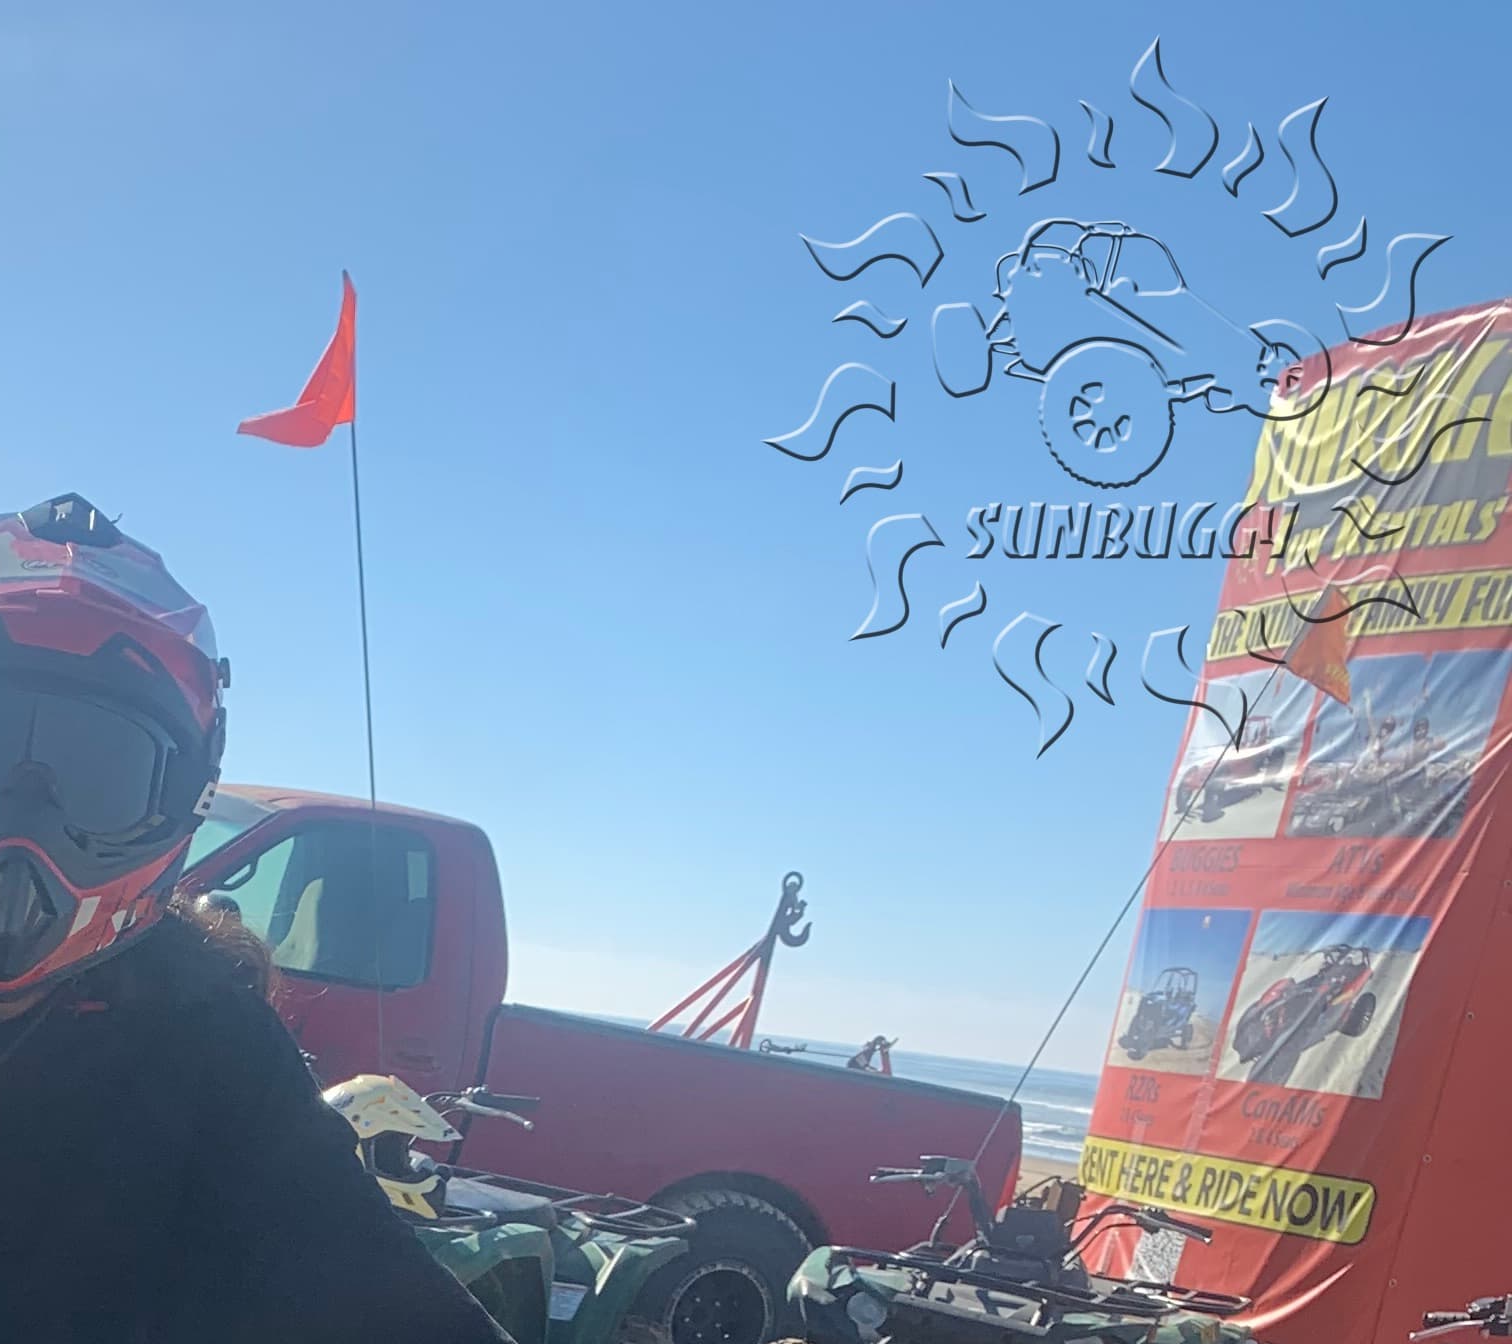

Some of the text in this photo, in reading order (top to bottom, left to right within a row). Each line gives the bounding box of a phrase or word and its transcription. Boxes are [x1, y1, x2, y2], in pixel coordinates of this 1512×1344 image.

[1210, 608, 1246, 656] THE
[1350, 577, 1460, 633] FAMILY
[1240, 1089, 1328, 1129] CanAMs
[1116, 1151, 1174, 1199] HERE
[1172, 1161, 1193, 1204] &
[1195, 1166, 1262, 1217] RIDE
[1260, 1177, 1364, 1233] NOW
